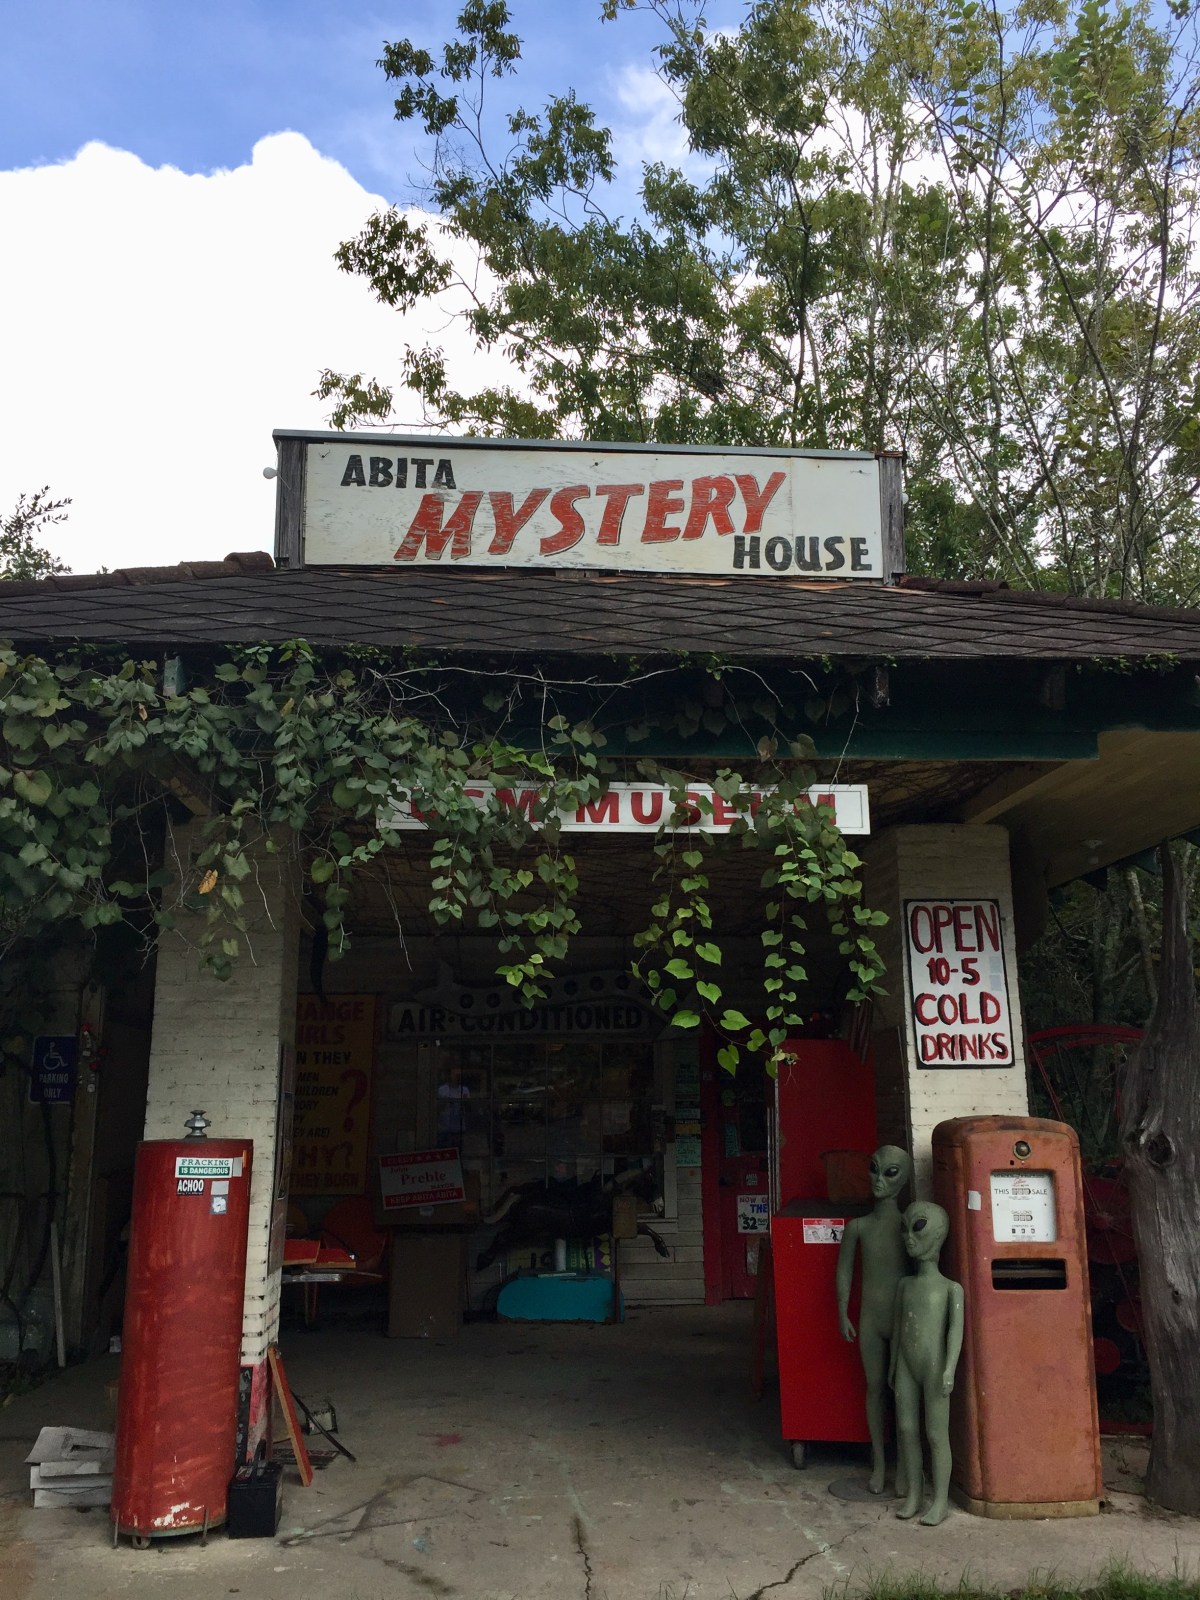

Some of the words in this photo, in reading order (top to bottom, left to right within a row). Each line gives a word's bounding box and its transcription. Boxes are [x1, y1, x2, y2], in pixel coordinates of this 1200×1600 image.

[340, 454, 456, 489] ABITA
[393, 471, 786, 561] MYSTERY
[732, 534, 872, 572] HOUSE
[909, 904, 1000, 954] OPEN
[926, 957, 981, 986] 10-5
[914, 991, 1001, 1026] COLD
[921, 1032, 1009, 1062] DRINKS
[39, 1073, 69, 1084] PARKING
[44, 1087, 62, 1098] ONLY
[177, 1179, 204, 1192] ACHOO
[400, 1171, 447, 1185] Preble
[742, 1216, 758, 1230] 32
